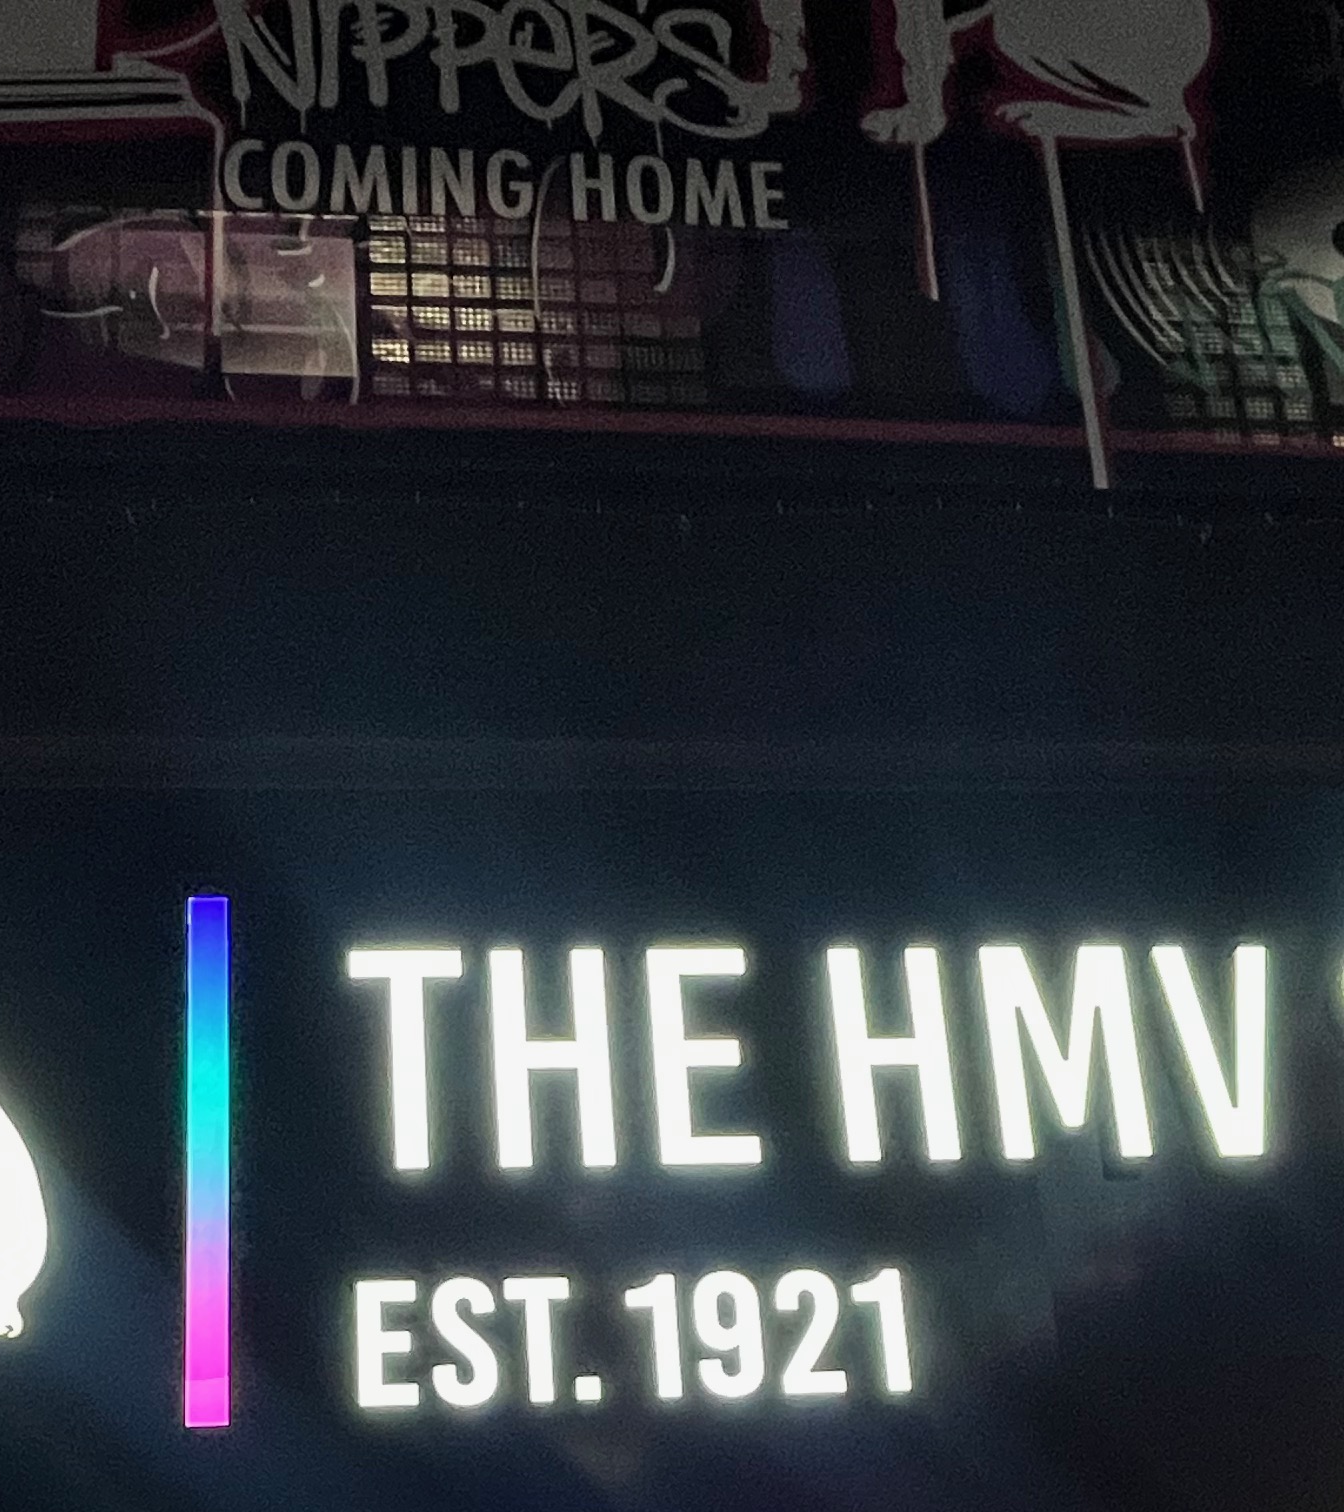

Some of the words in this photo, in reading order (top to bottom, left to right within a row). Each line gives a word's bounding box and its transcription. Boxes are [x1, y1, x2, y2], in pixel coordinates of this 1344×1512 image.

[222, 137, 536, 220] COMING
[570, 150, 791, 230] HOME
[346, 944, 763, 1174] THE
[824, 942, 1271, 1166] HMV
[354, 1276, 602, 1410] EST.
[624, 1267, 914, 1402] 1921
